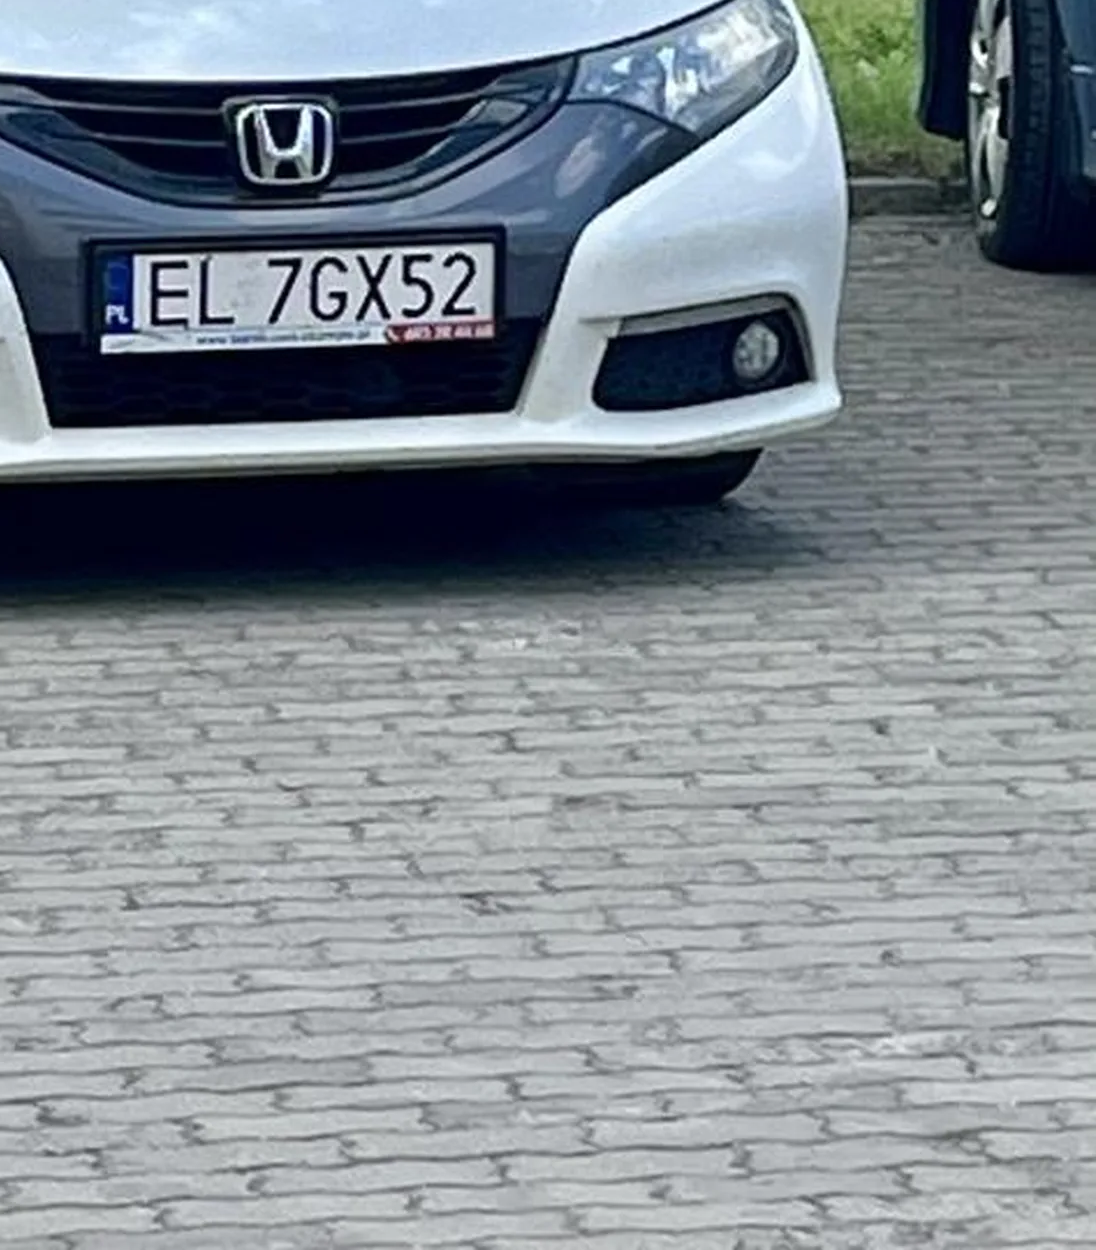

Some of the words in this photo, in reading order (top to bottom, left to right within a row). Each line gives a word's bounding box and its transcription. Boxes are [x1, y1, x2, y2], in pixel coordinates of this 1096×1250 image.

[150, 256, 236, 327] EL
[267, 252, 478, 325] 7GX52
[105, 305, 130, 325] PL
